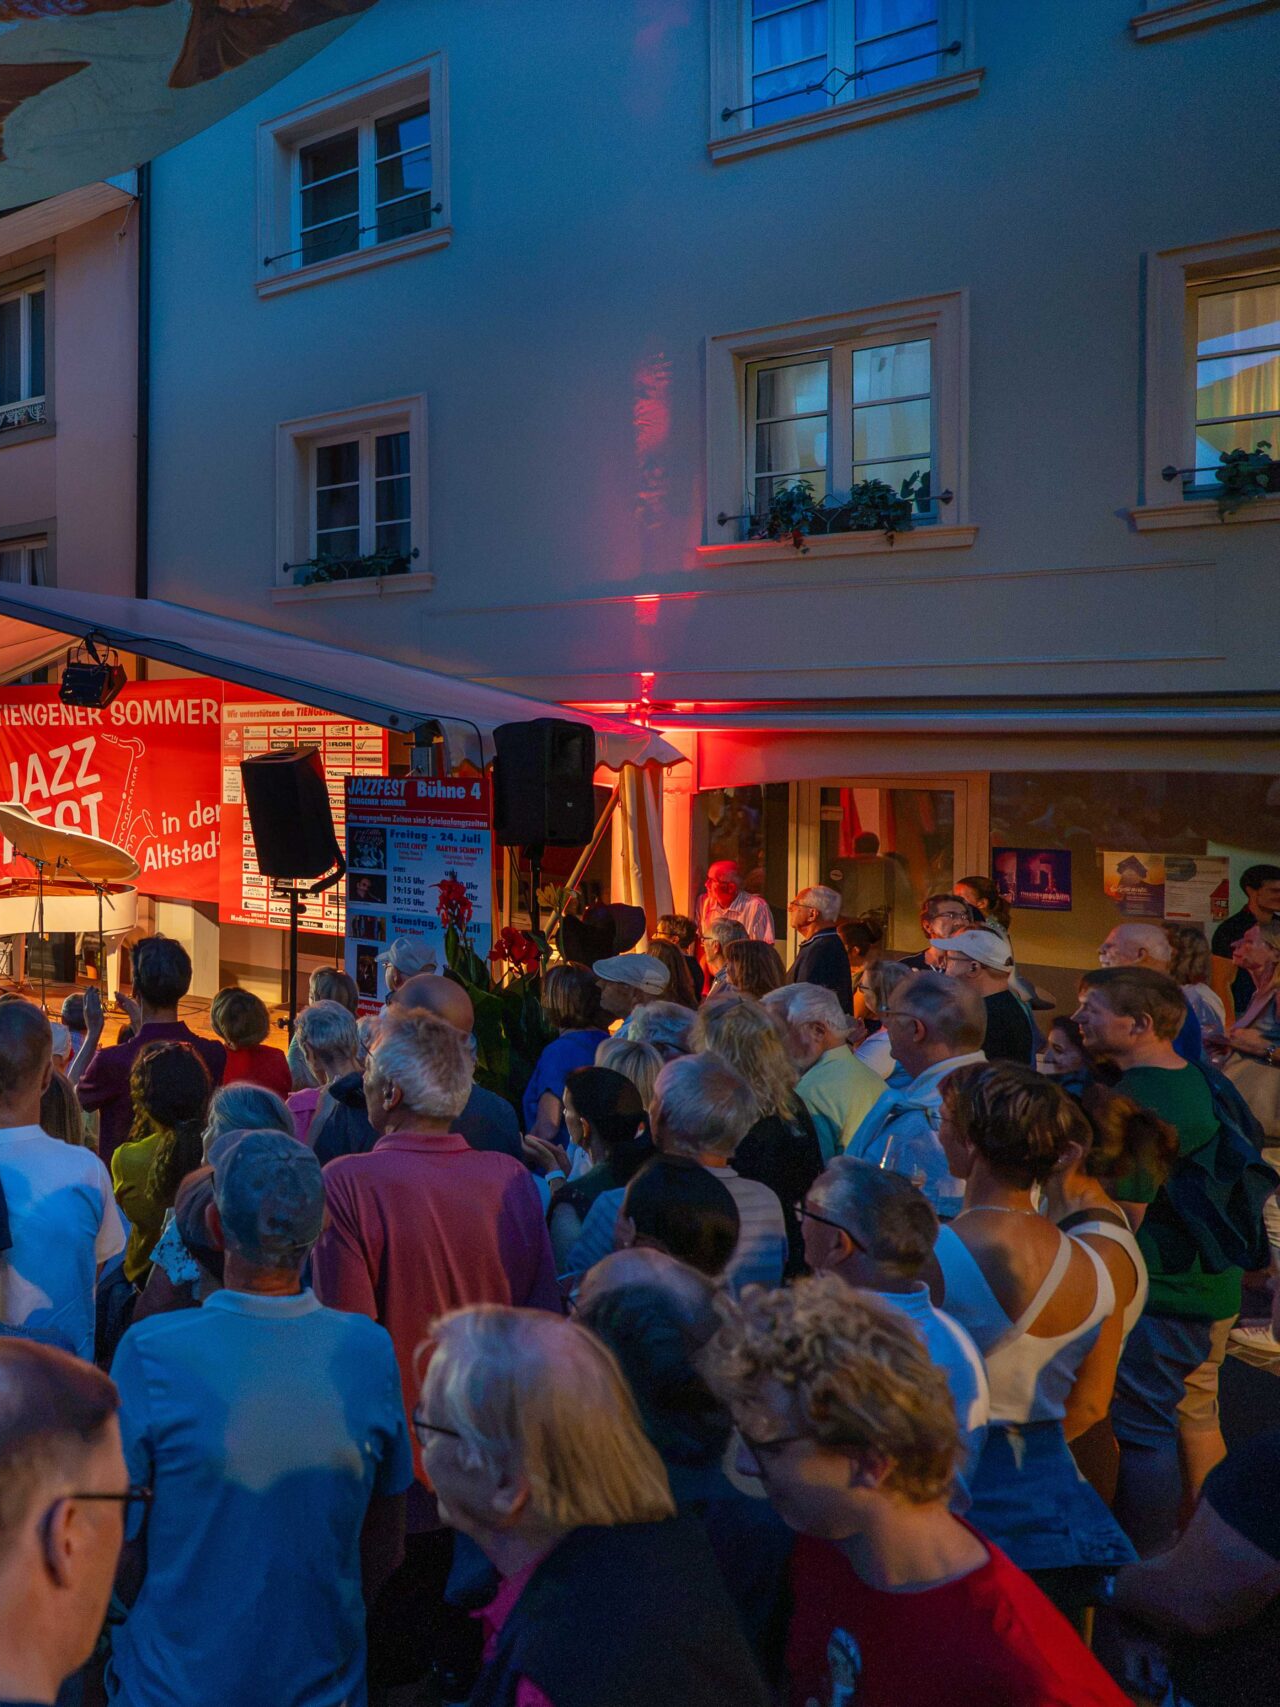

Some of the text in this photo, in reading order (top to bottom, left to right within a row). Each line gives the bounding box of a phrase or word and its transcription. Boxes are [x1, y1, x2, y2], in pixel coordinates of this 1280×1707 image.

[110, 698, 220, 726] SOMMER
[227, 709, 238, 718] Wir
[240, 708, 281, 718] unterstützen
[282, 707, 295, 717] den
[6, 735, 102, 805] JAZZ
[348, 778, 407, 797] JAZZFEST
[416, 780, 466, 799] Bühne
[470, 782, 482, 800] 4
[348, 797, 379, 805] TIENGENER
[161, 811, 180, 835] in
[392, 815, 412, 823] Zeiten
[413, 816, 426, 824] sind
[427, 816, 488, 828] Spielanfangszeiten
[389, 829, 429, 842] Freitag
[440, 832, 458, 842] 24.
[460, 833, 481, 844] Juli
[436, 844, 458, 852] MARTIN
[393, 875, 425, 886] 18:15 Uhr
[465, 881, 479, 890] Uhr
[393, 885, 425, 896] 19:15 Uhr
[392, 896, 425, 907] 20:15 Uhr
[391, 915, 438, 930] Samstag,
